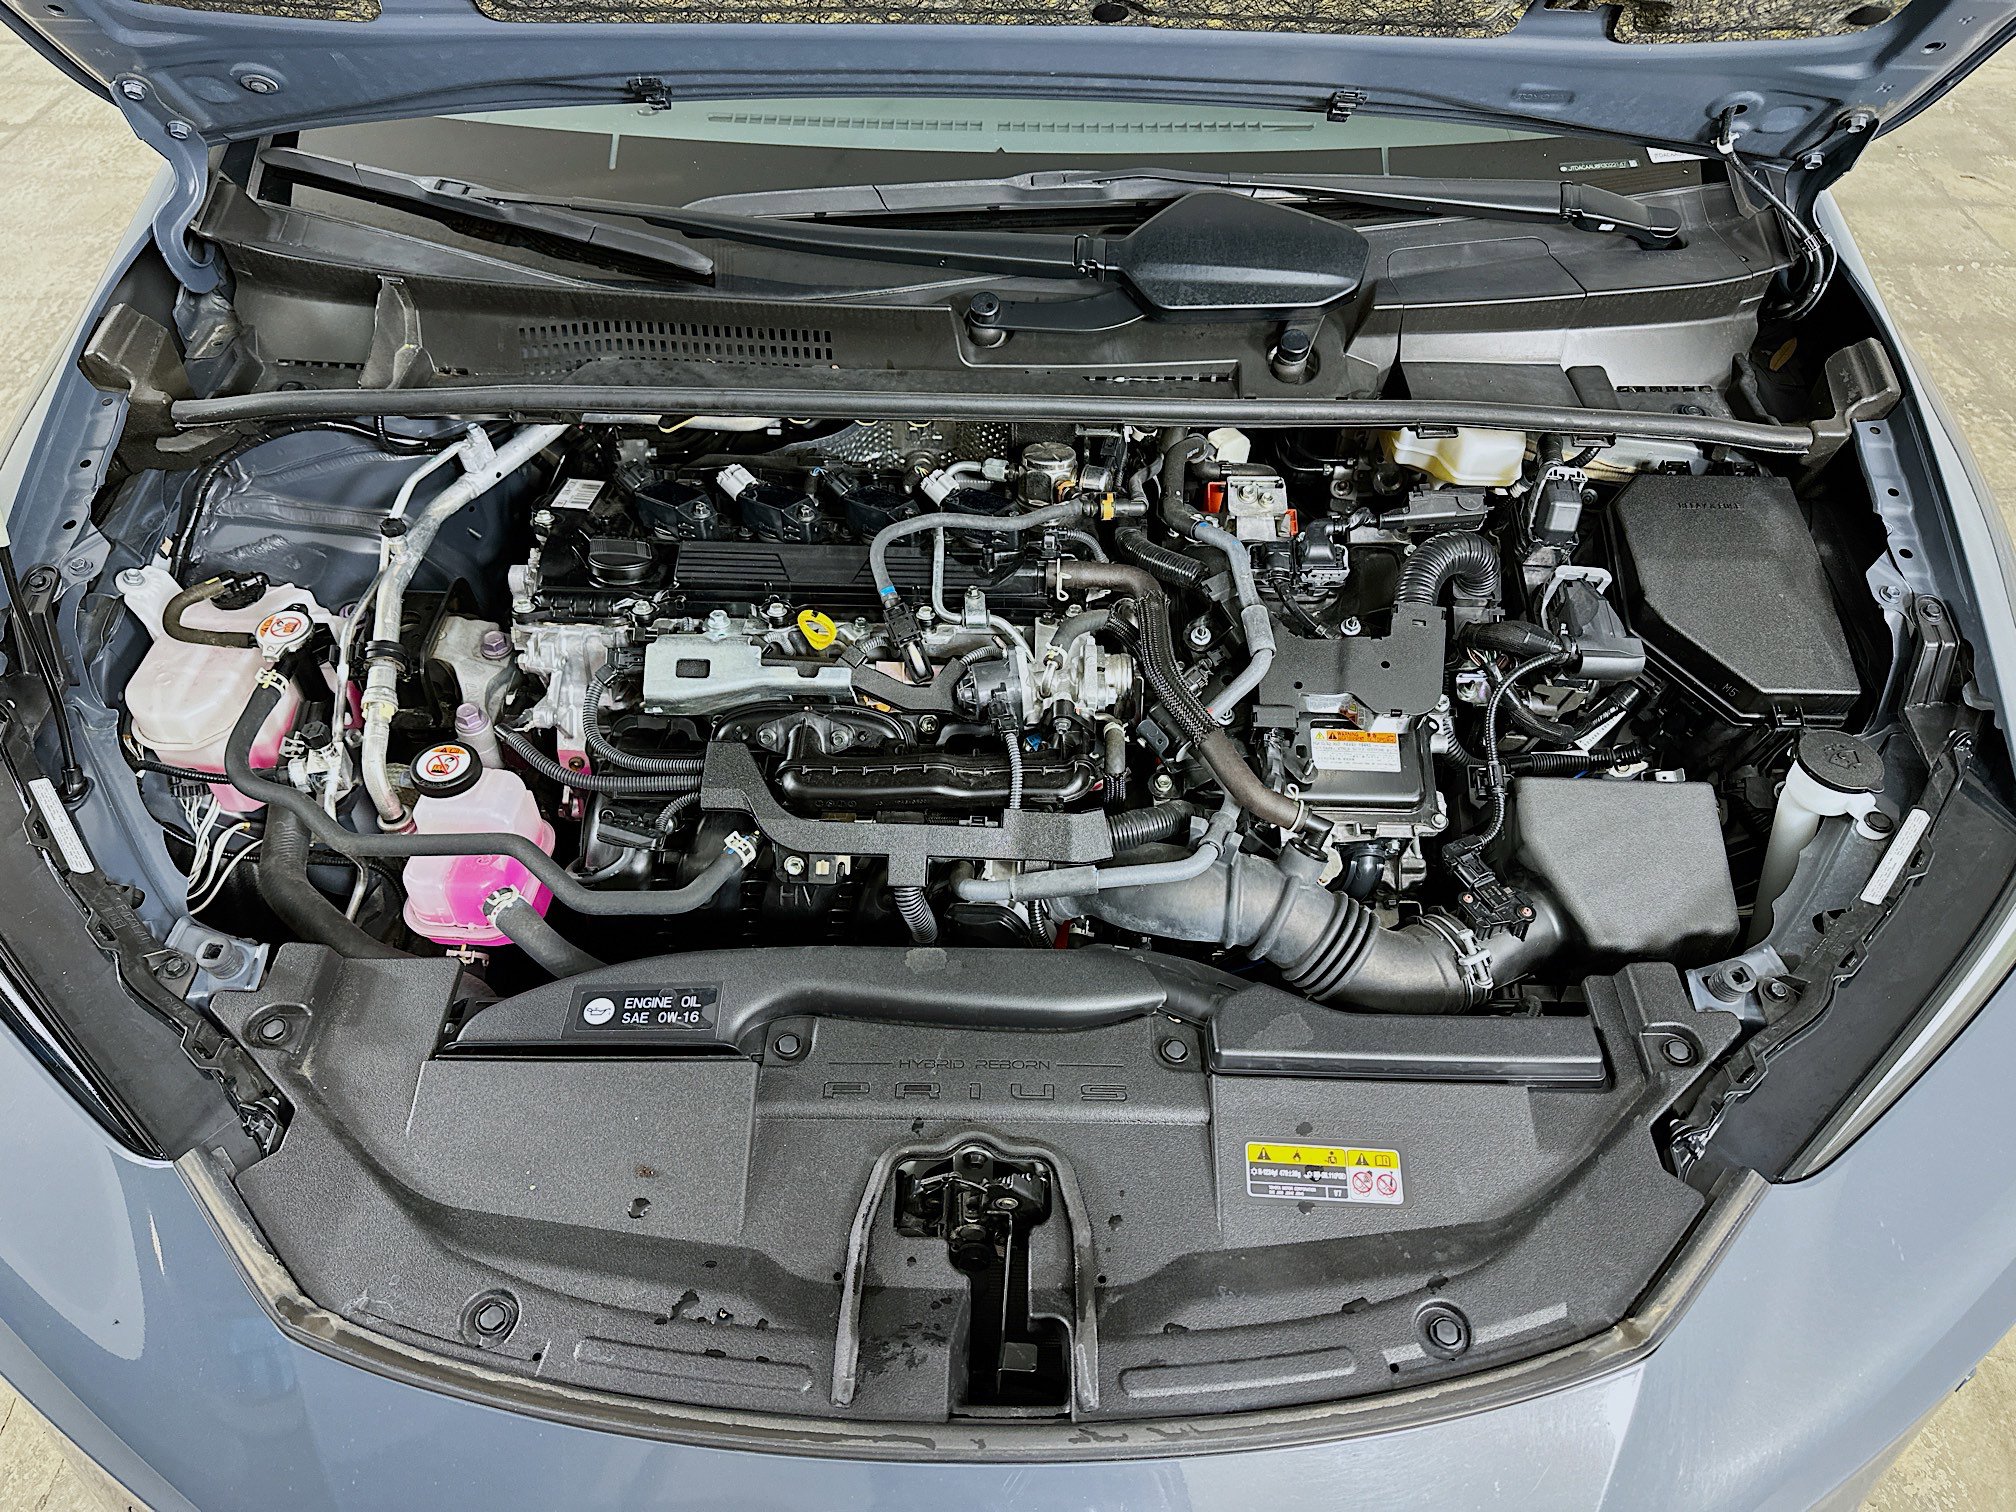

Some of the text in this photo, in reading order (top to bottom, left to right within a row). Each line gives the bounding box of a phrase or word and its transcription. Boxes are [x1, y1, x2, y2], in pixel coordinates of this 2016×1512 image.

[780, 885, 819, 908] HV
[624, 996, 702, 1009] ENGINE OIL
[622, 1011, 700, 1024] SAE 0W-16
[900, 1060, 1051, 1070] HYBRID REBORN
[822, 1081, 1128, 1102] PRIUS
